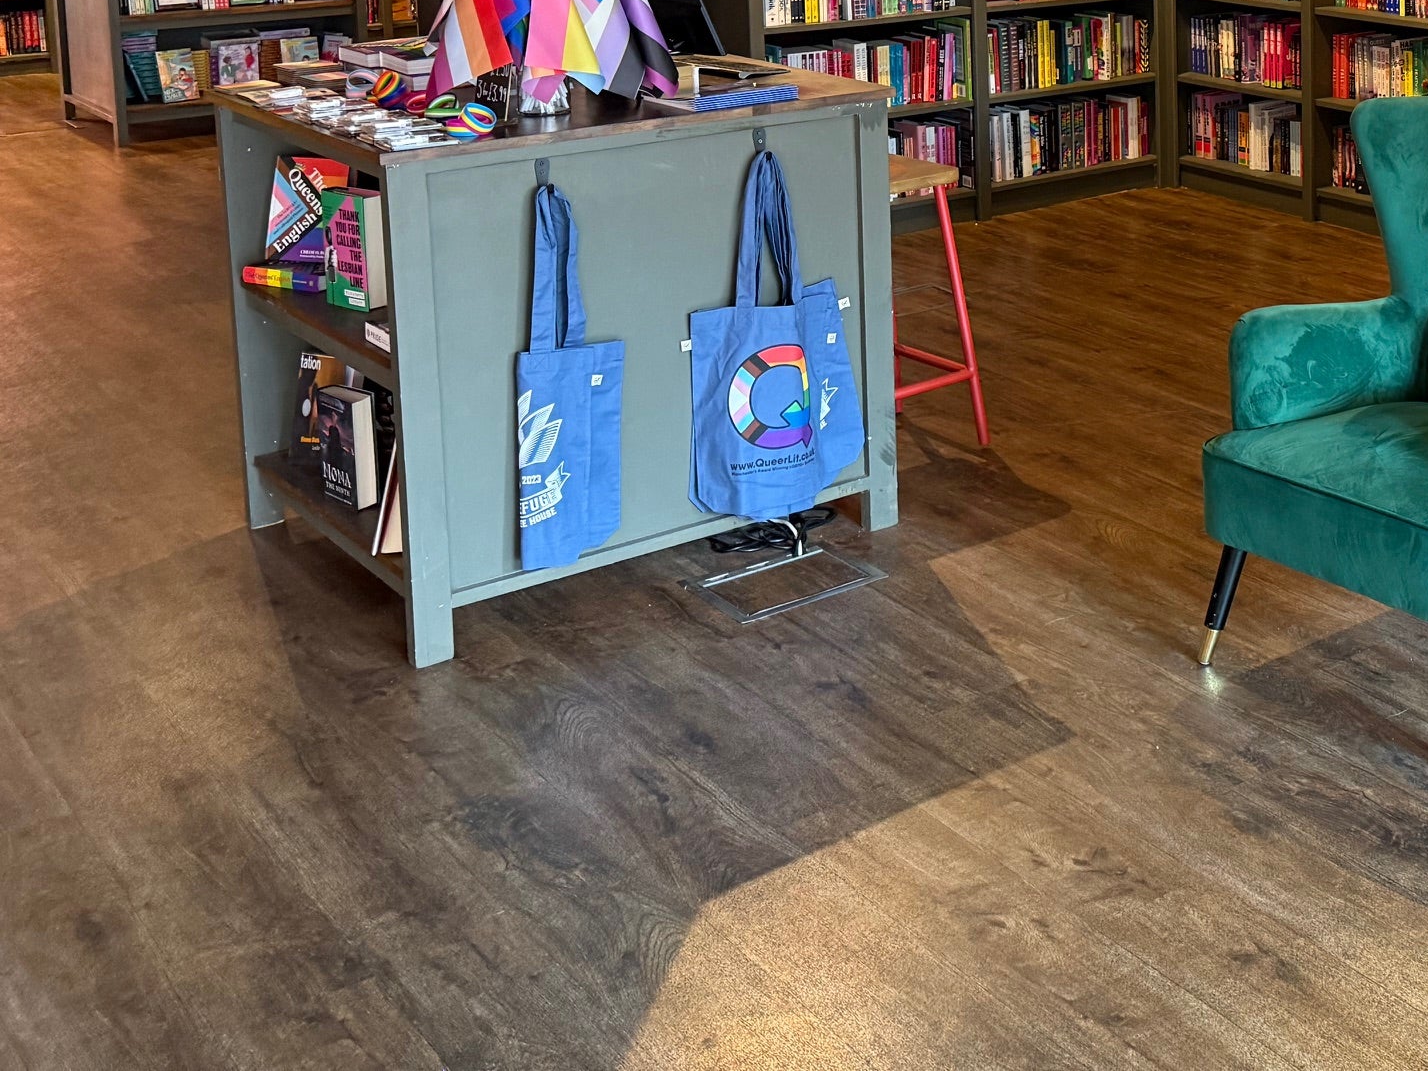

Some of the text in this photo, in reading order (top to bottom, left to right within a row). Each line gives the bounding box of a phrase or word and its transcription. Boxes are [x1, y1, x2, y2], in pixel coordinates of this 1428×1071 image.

[307, 168, 327, 194] The
[288, 168, 323, 216] Queens
[339, 209, 359, 223] THANK
[273, 212, 317, 253] English
[335, 221, 361, 236] YOU FOR
[336, 234, 361, 249] CALLING
[350, 250, 362, 263] THE
[337, 261, 363, 276] LESBIAN
[350, 278, 364, 289] LINE
[323, 461, 352, 488] NONA
[522, 475, 541, 484] 2023
[529, 507, 557, 525] HOUSE
